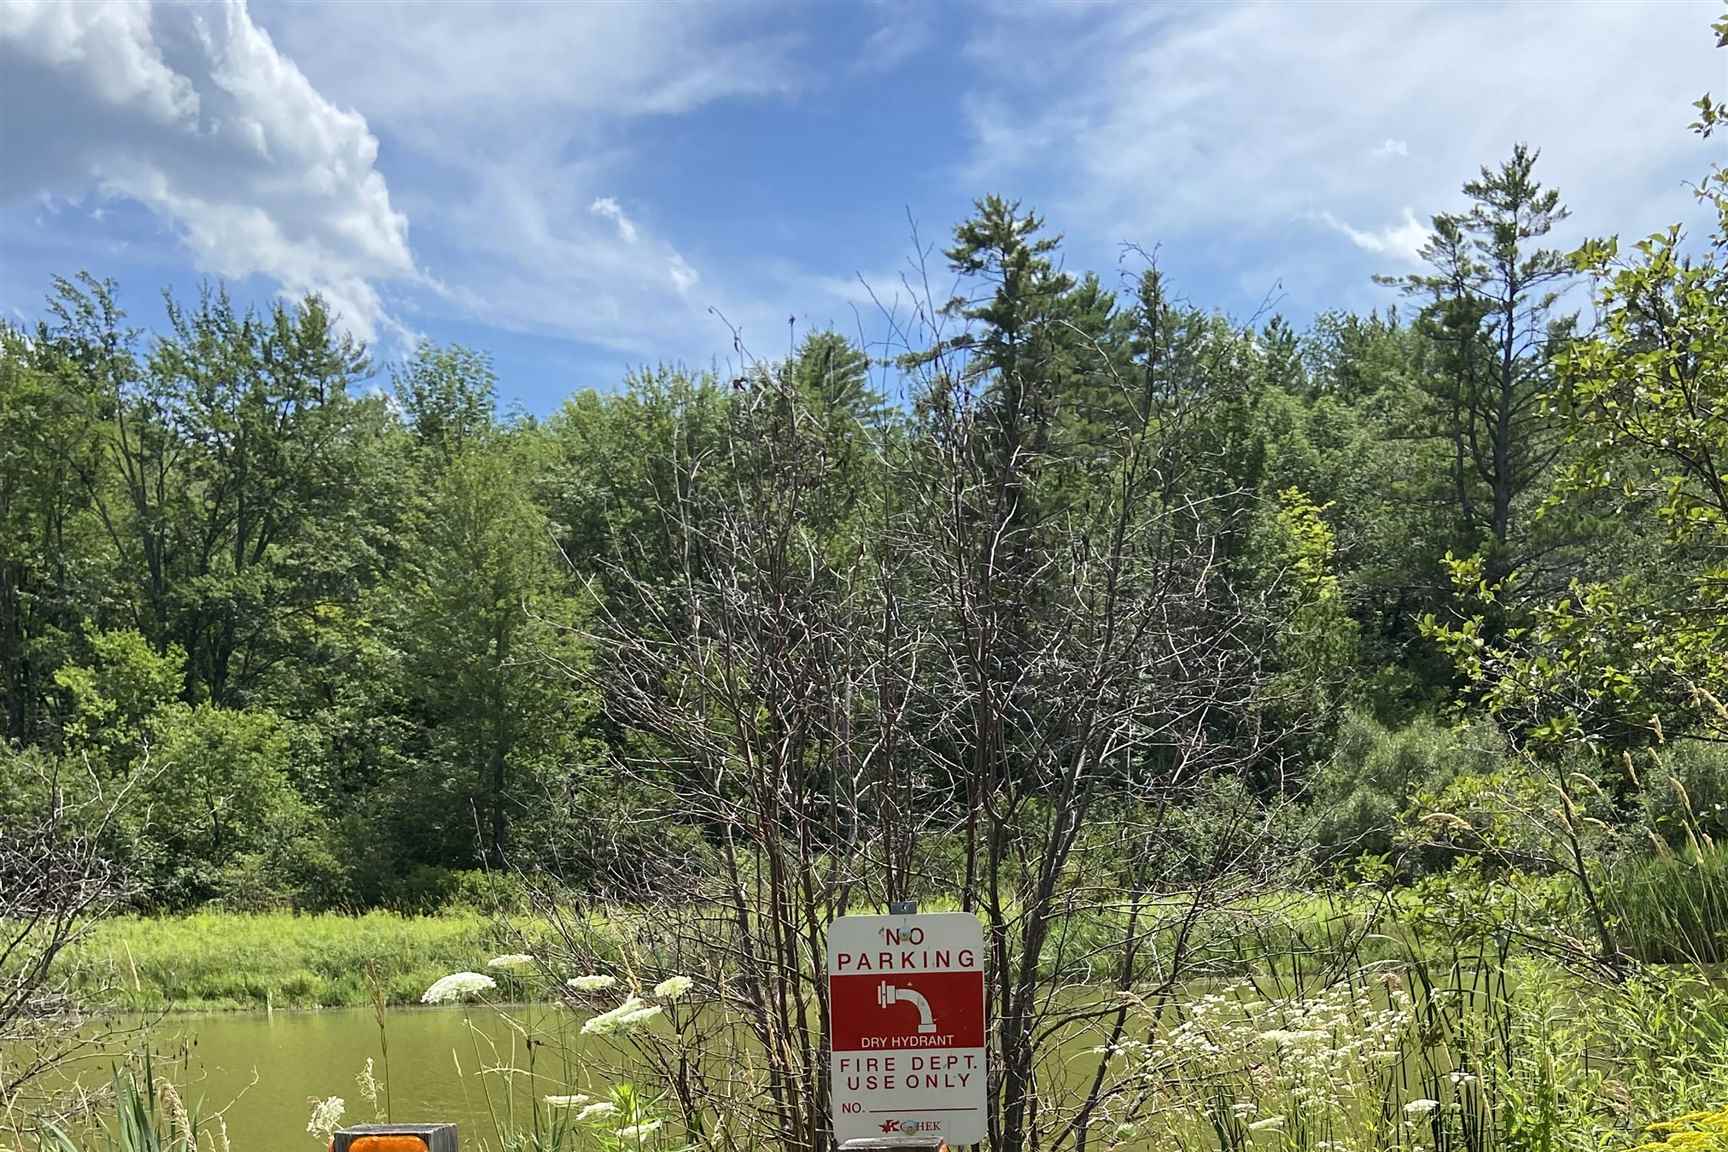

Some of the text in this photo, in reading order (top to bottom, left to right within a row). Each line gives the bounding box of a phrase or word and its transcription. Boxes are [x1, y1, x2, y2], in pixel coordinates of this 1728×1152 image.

[885, 927, 925, 946] NO
[837, 949, 975, 970] PARKING
[861, 1034, 955, 1048] DRY HYDRANT
[840, 1055, 977, 1072] FIRE DEPT.
[848, 1073, 970, 1090] USE ONLY
[842, 1102, 866, 1114] NO.
